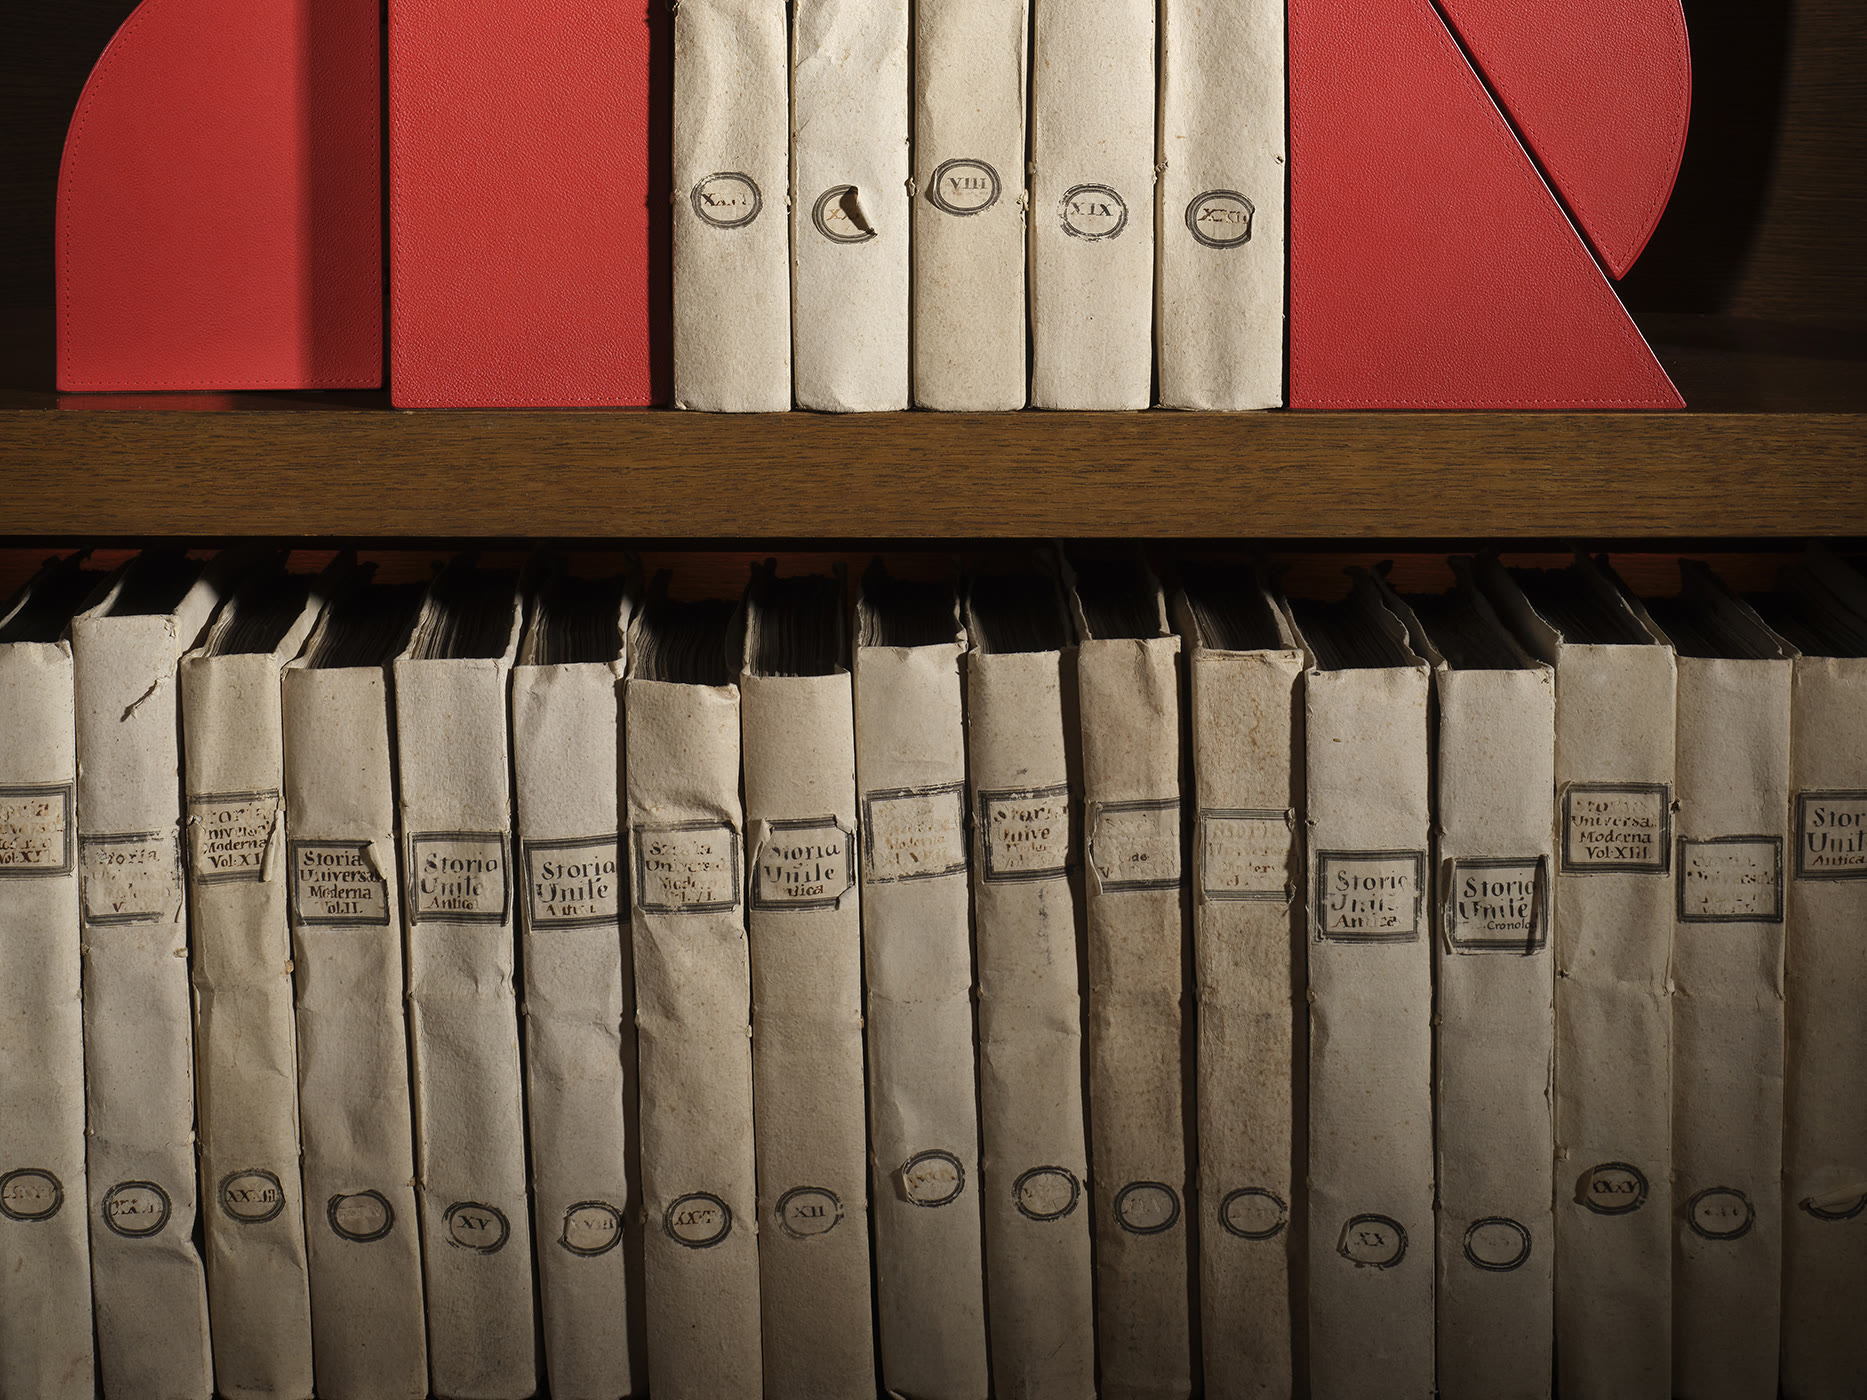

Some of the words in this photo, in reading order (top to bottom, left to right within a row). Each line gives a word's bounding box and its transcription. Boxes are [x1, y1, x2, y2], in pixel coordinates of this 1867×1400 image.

[1070, 201, 1115, 217] XIX
[1579, 829, 1652, 844] Moderna
[302, 849, 364, 868] Storia
[423, 851, 499, 875] Storia
[541, 855, 616, 881] Storia
[792, 1205, 827, 1219] XII
[456, 1215, 495, 1231] XV
